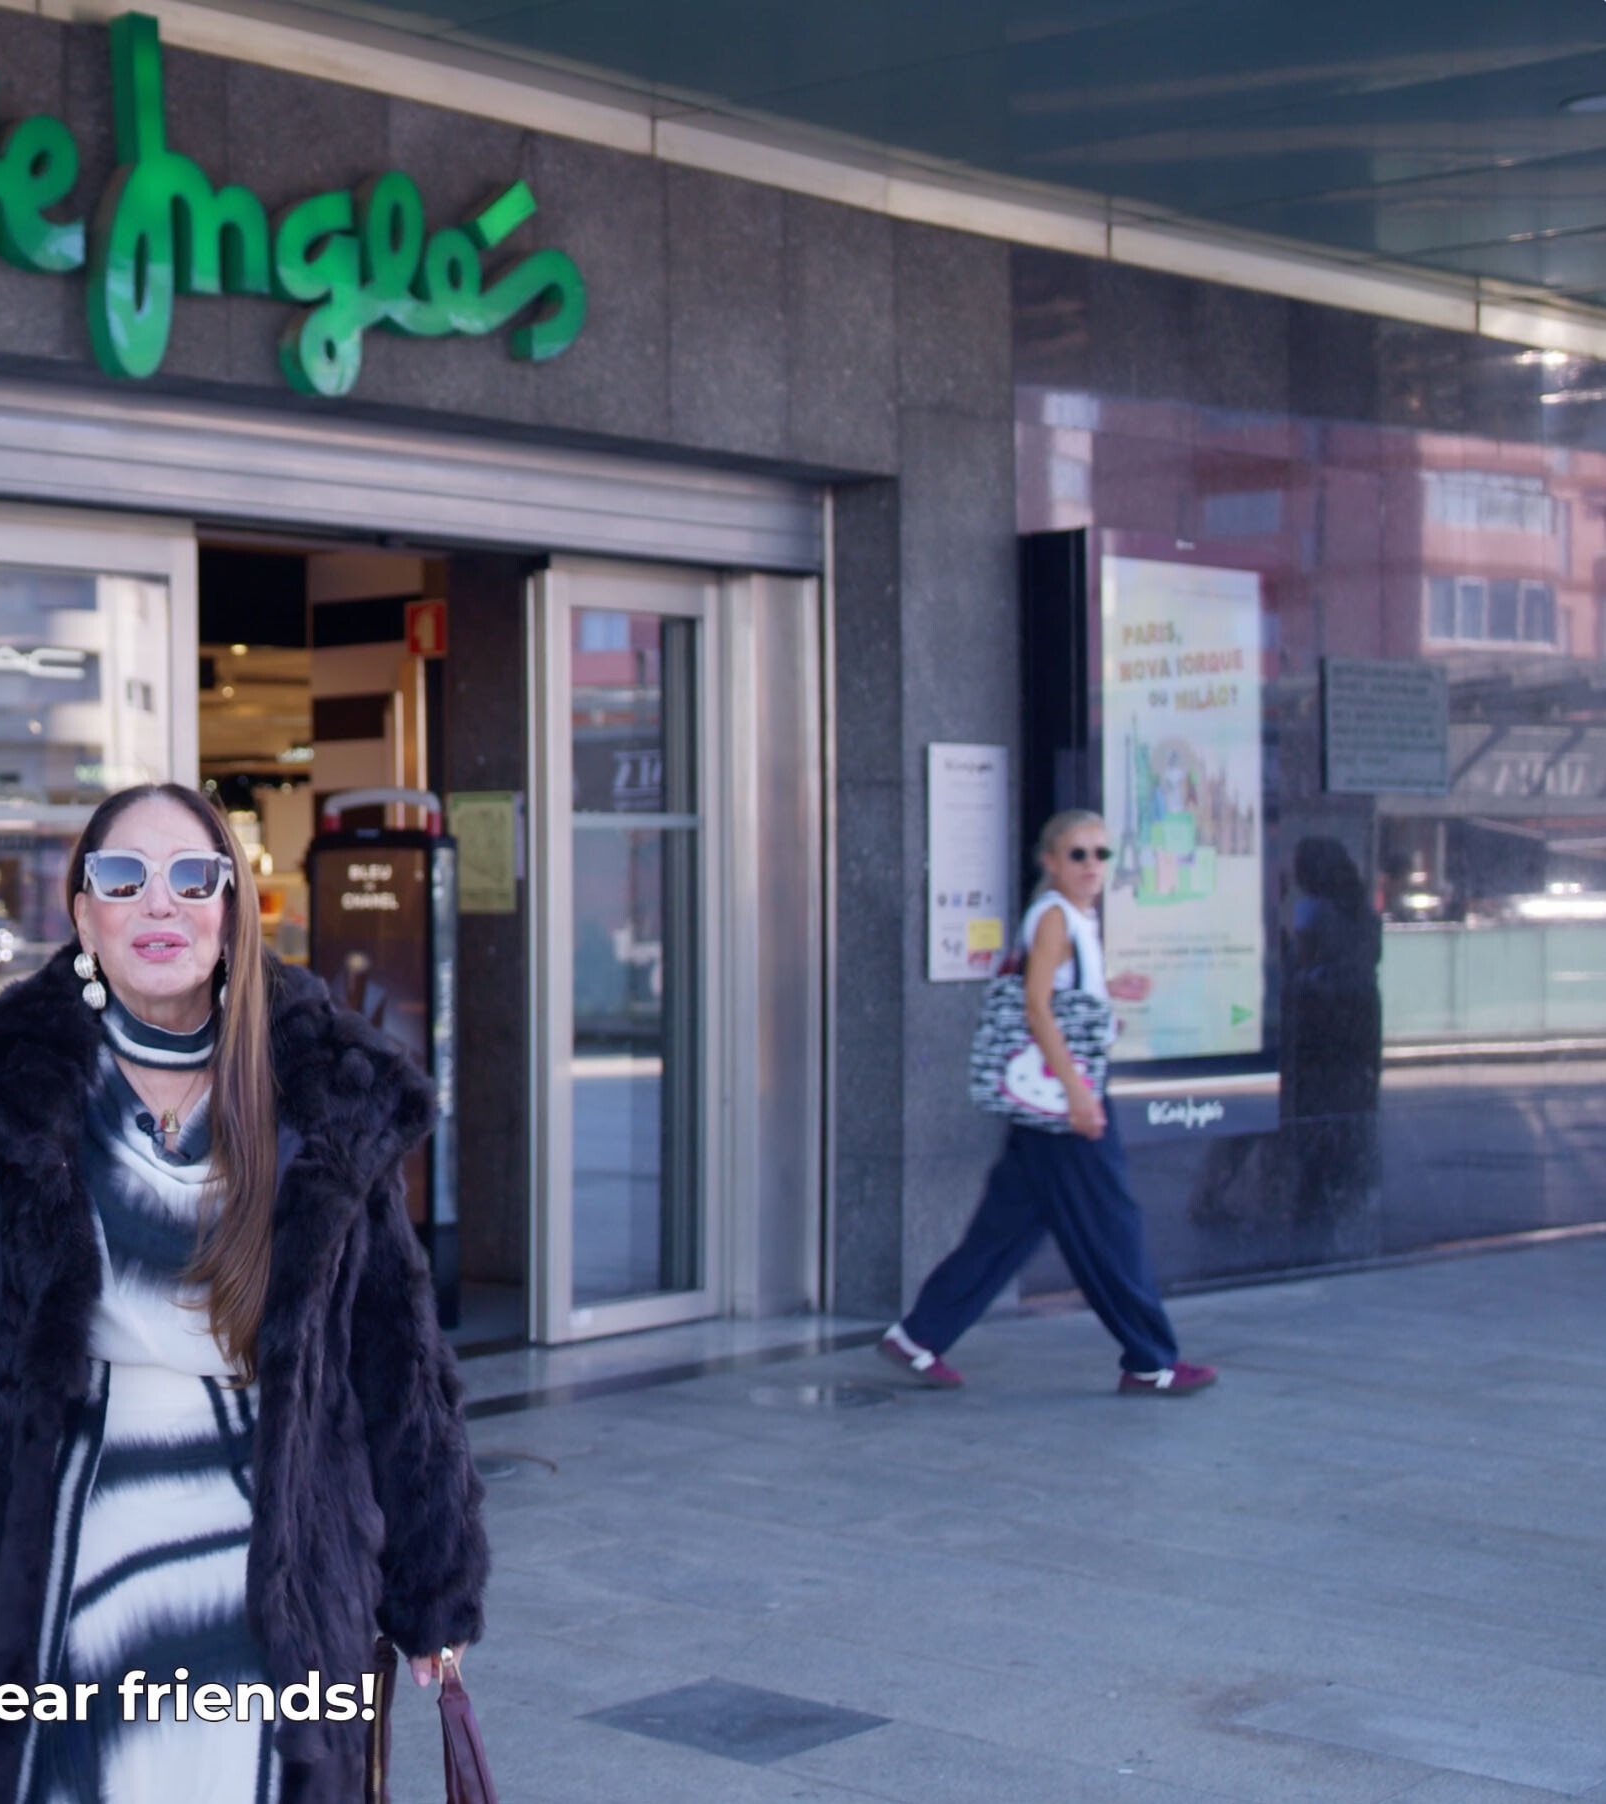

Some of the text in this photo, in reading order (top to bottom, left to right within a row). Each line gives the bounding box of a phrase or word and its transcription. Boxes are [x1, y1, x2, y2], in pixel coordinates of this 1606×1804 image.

[87, 10, 587, 397] Inglés
[348, 864, 393, 882] BLEU
[341, 892, 400, 911] CHANEL
